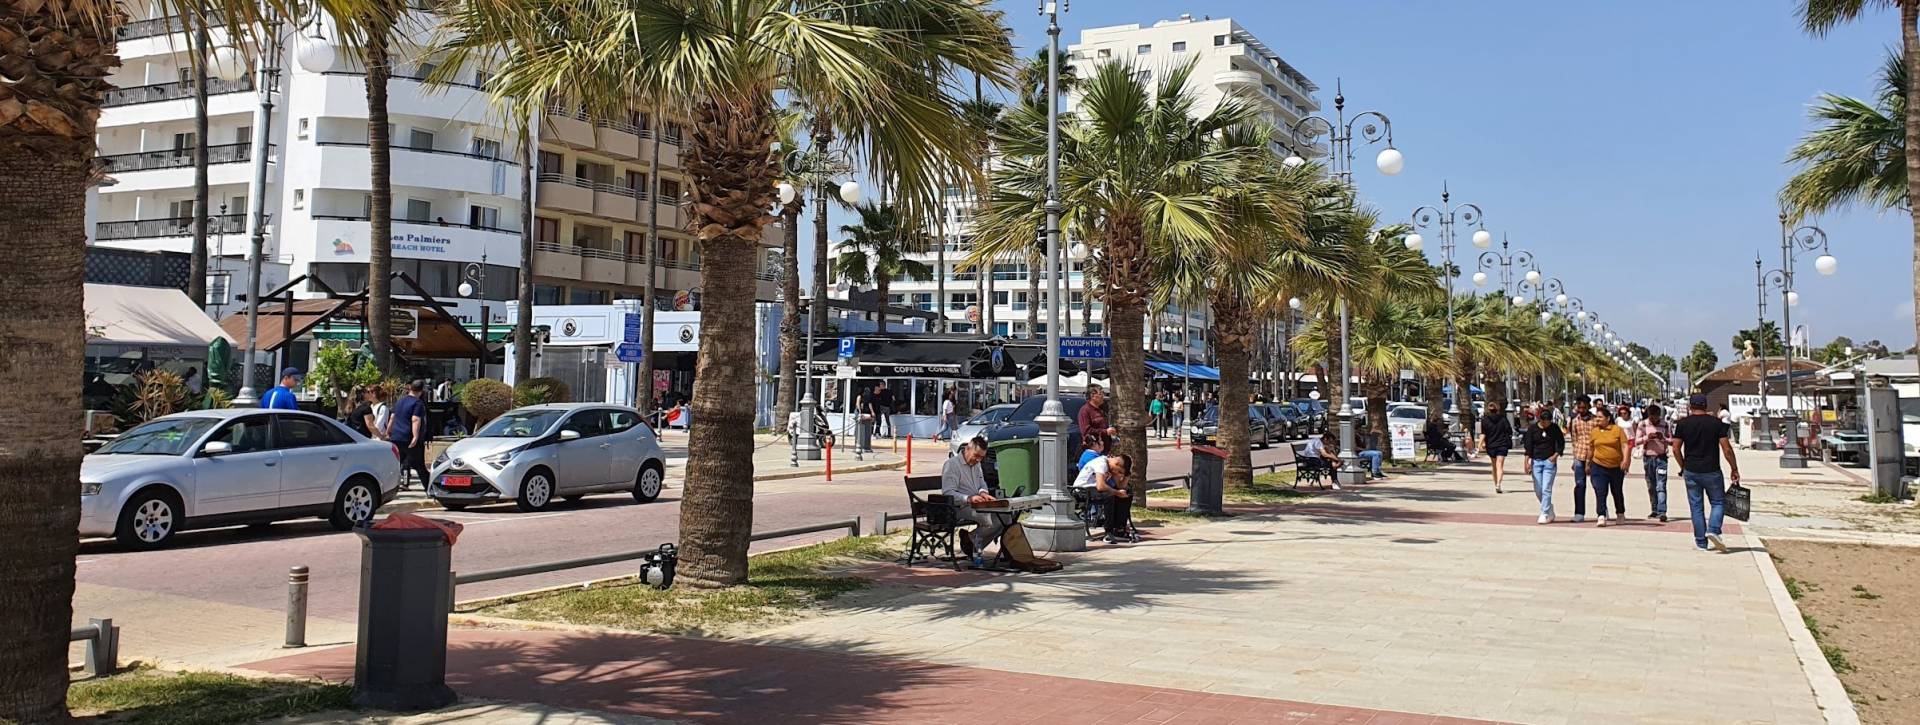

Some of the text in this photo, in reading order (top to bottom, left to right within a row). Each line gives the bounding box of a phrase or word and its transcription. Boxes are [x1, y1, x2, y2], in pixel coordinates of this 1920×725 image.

[407, 234, 451, 244] Palmiers
[420, 245, 446, 253] HOTEL
[841, 340, 851, 352] P
[927, 366, 960, 374] CORNER
